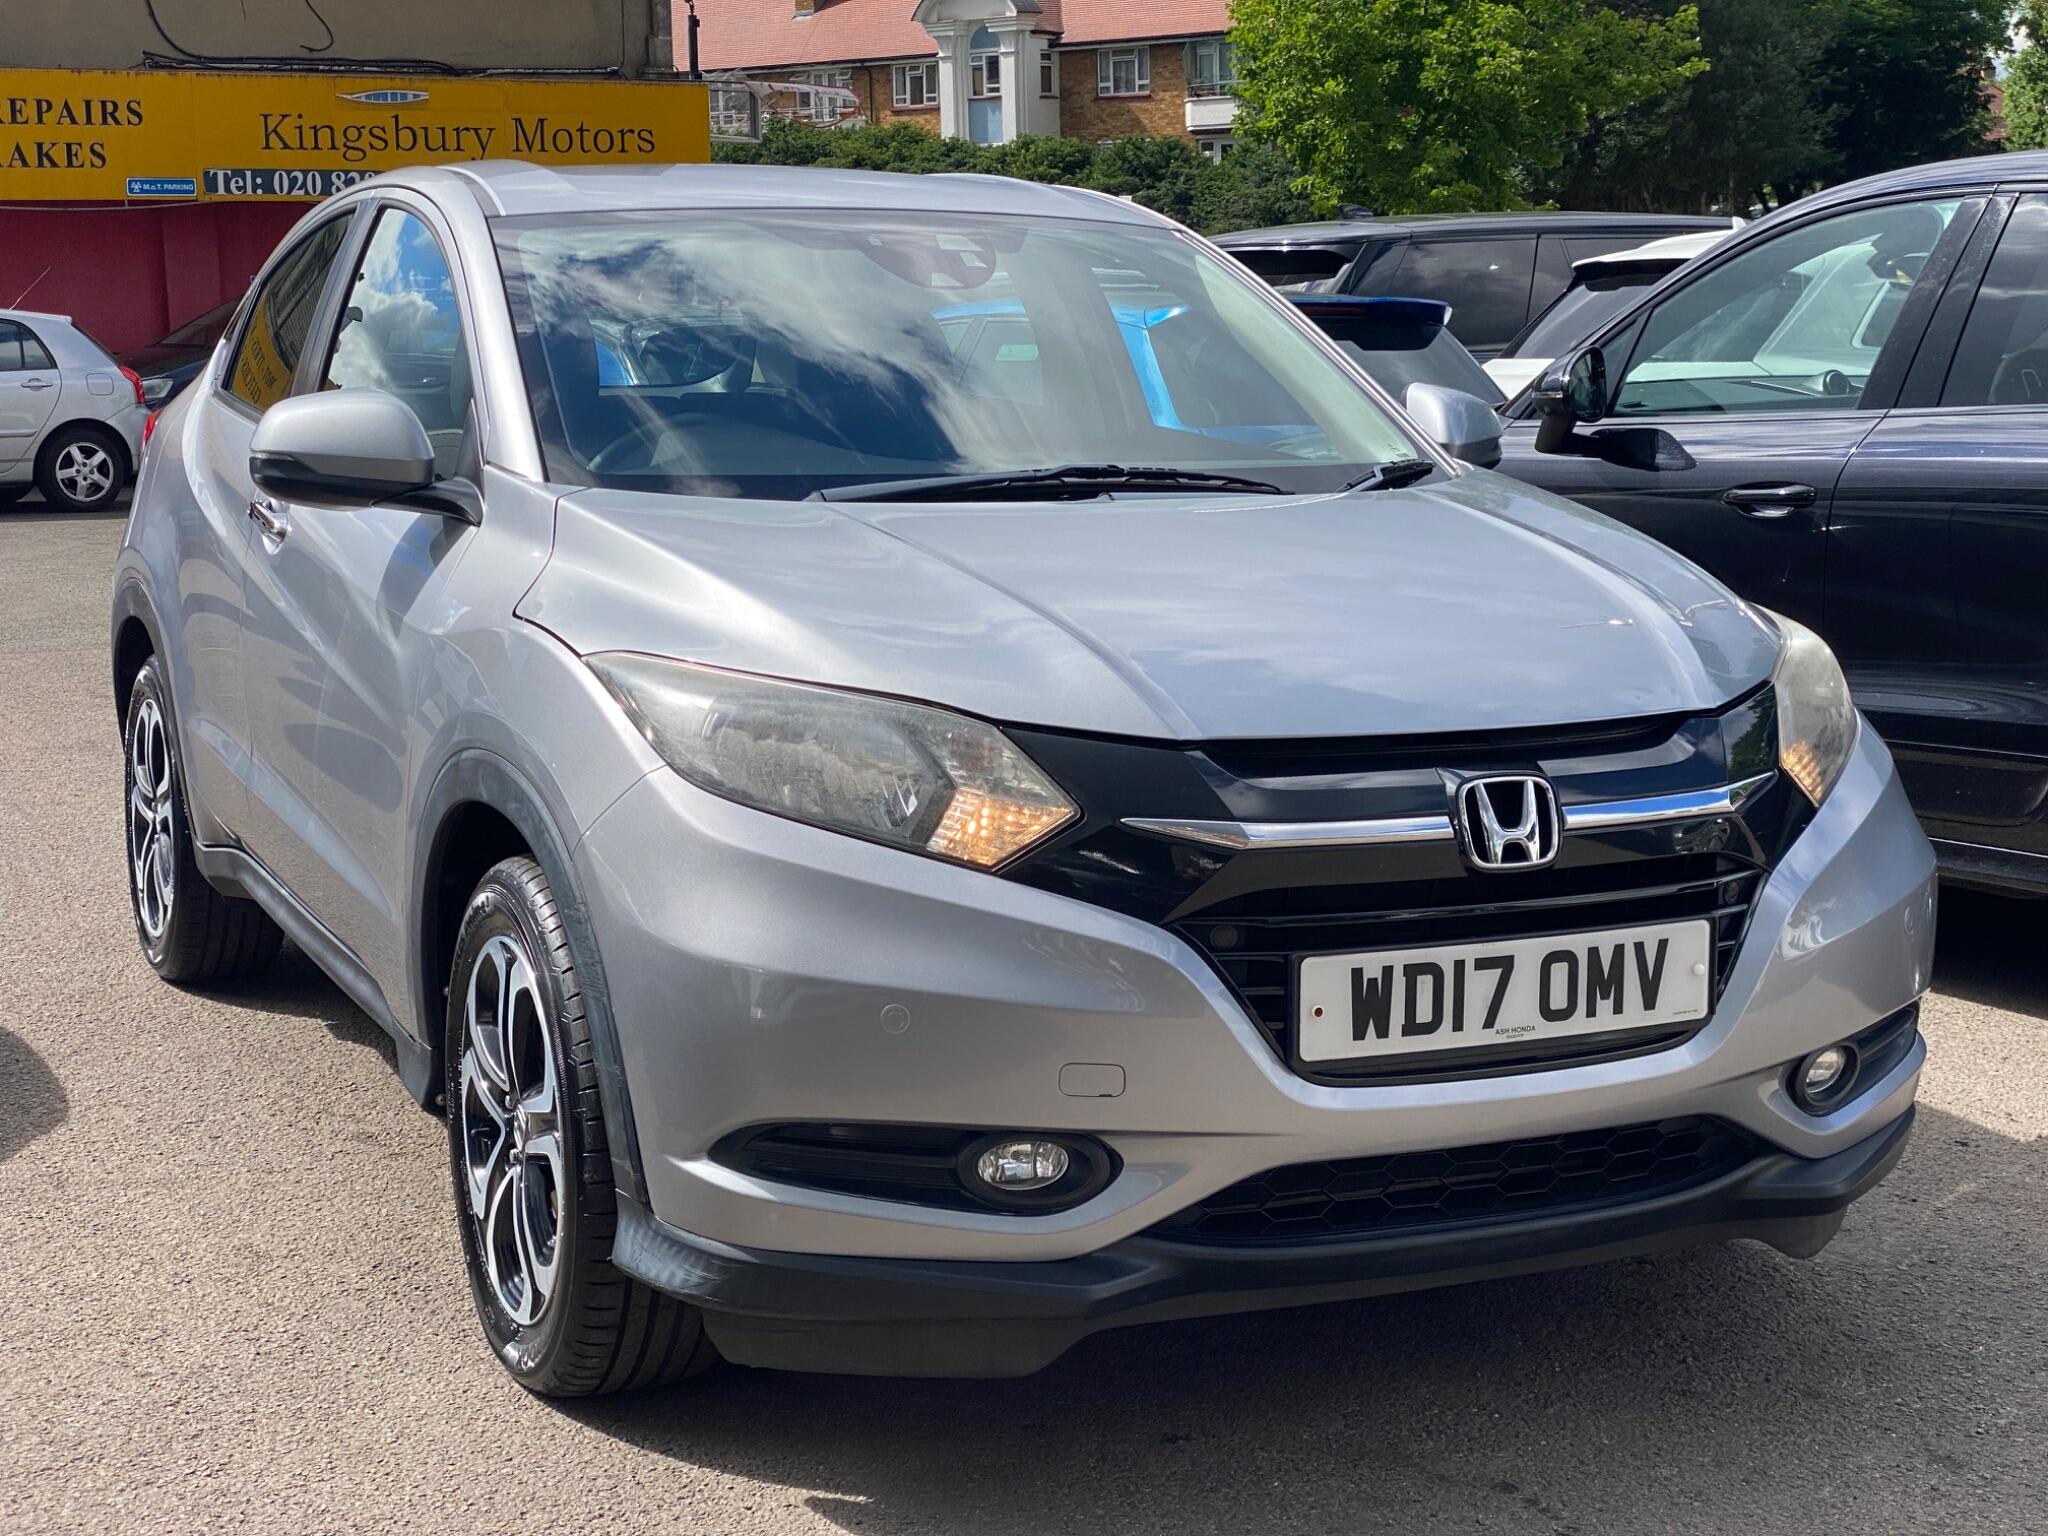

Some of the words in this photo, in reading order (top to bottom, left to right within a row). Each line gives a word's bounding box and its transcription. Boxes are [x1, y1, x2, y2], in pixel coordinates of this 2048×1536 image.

[0, 97, 144, 127] EPAIRS
[259, 112, 495, 162] Kingsbury
[511, 117, 656, 154] Motors
[0, 140, 108, 169] AKES
[163, 183, 194, 191] PARKING
[209, 169, 263, 196] Tel:
[273, 170, 322, 196] 020
[1350, 954, 1515, 1042] WD17
[1538, 938, 1669, 1023] OMV
[1495, 1027, 1510, 1035] ASH
[1511, 1025, 1536, 1034] HONDA
